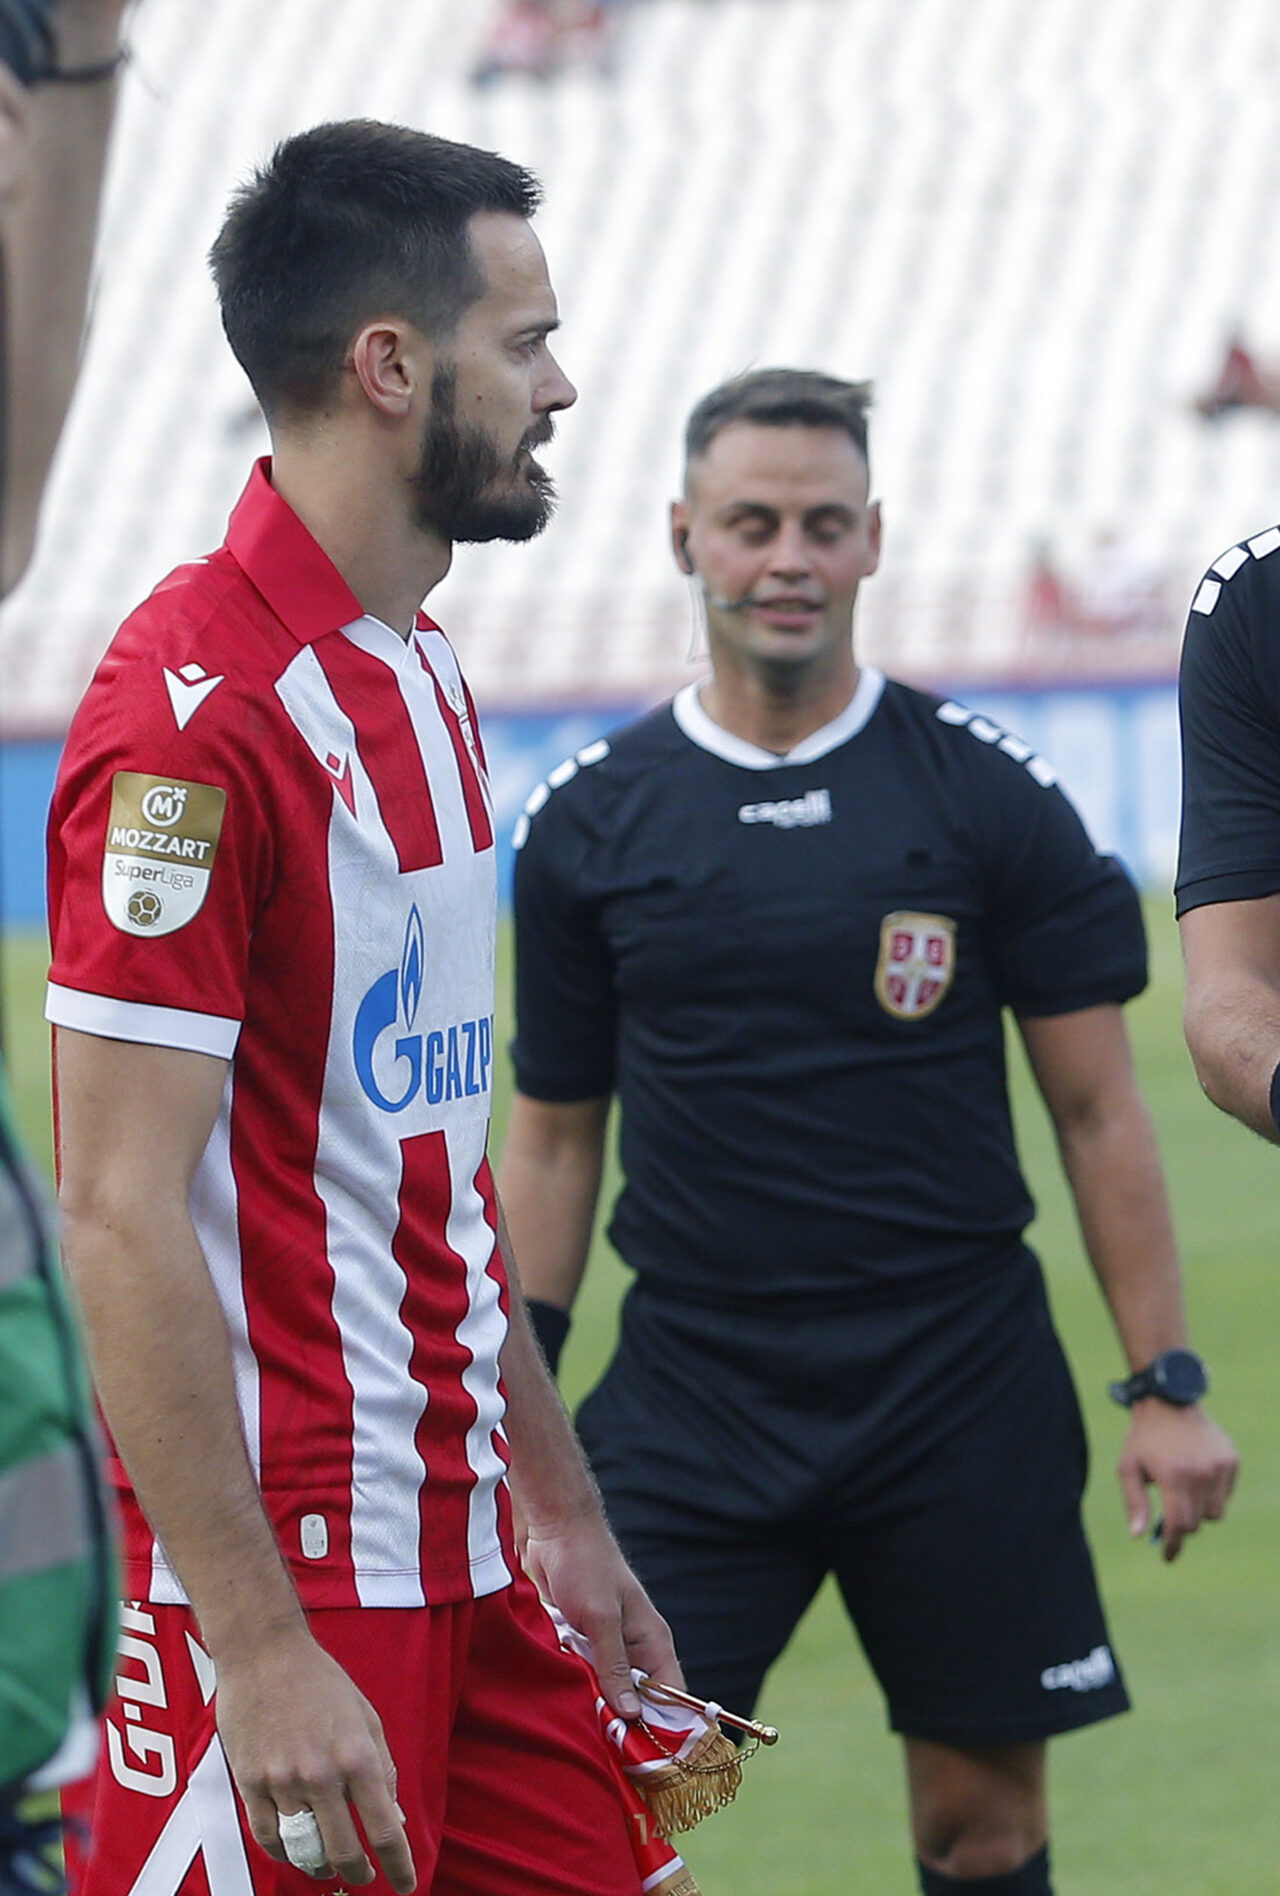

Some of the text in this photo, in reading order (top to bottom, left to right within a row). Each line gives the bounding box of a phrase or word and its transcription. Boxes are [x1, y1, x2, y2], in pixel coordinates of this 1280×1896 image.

[110, 826, 211, 860] MOZZART
[114, 859, 194, 891] SuperLiga
[426, 1014, 494, 1105] GAZP
